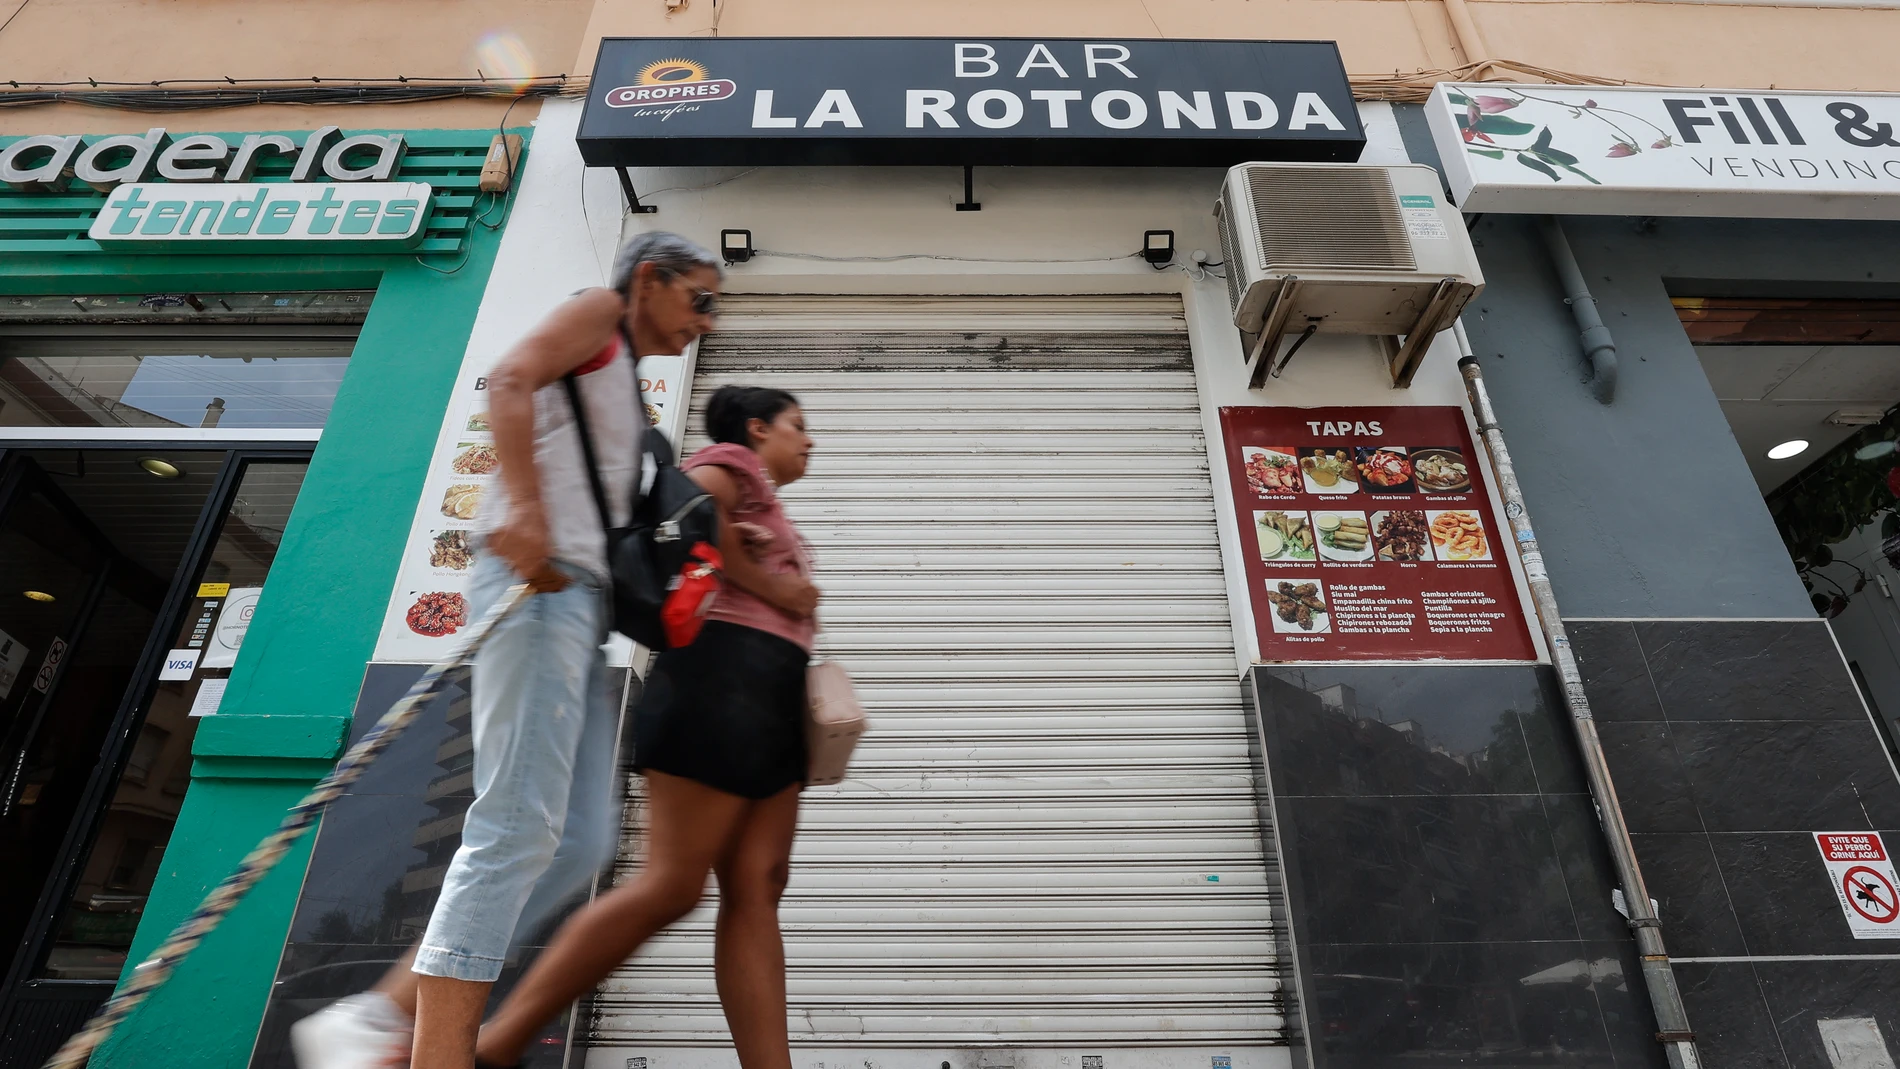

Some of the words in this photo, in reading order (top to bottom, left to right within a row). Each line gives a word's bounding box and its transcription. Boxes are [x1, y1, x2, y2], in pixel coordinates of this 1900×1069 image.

[955, 43, 1138, 78] BAR
[619, 84, 721, 101] OROPRES
[751, 89, 863, 129] LA
[905, 89, 1346, 131] ROTONDA
[1662, 97, 1807, 145] Fill
[1825, 102, 1900, 147] &
[109, 187, 420, 235] tendetes
[1306, 421, 1384, 436] TAPAS
[1478, 597, 1496, 605] ajillo
[1381, 626, 1410, 634] plancha
[1430, 626, 1450, 634] Sepia
[1464, 626, 1493, 634] plancha
[168, 660, 193, 670] VISA
[1828, 836, 1850, 844] EVITE
[1851, 836, 1870, 844] QUE
[1830, 851, 1857, 859] ORINE
[1858, 849, 1881, 859] AQUÍ
